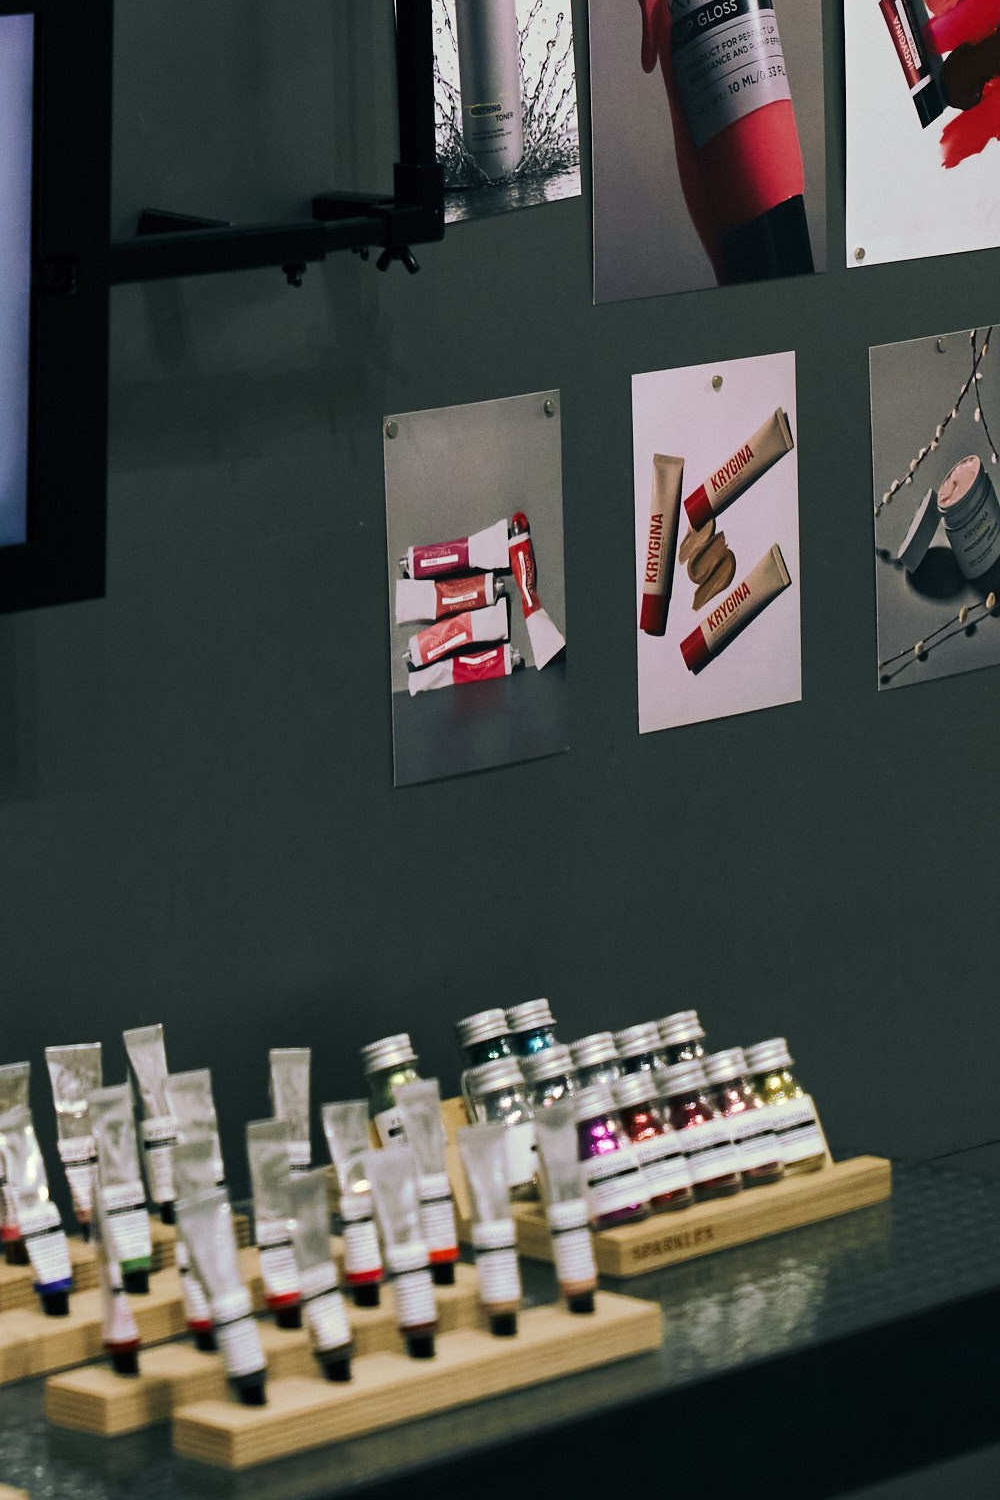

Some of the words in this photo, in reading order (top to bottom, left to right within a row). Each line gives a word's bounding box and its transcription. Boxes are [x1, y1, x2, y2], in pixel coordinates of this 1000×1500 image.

[697, 0, 738, 26] GLOSS
[722, 37, 738, 50] FOR
[733, 45, 749, 58] AND
[893, 15, 914, 68] KRYGINA
[728, 81, 741, 95] 10
[495, 111, 514, 122] TONER
[710, 444, 755, 493] KRYGINA
[645, 513, 664, 584] KRYGINA
[706, 581, 751, 631] KRYGINA
